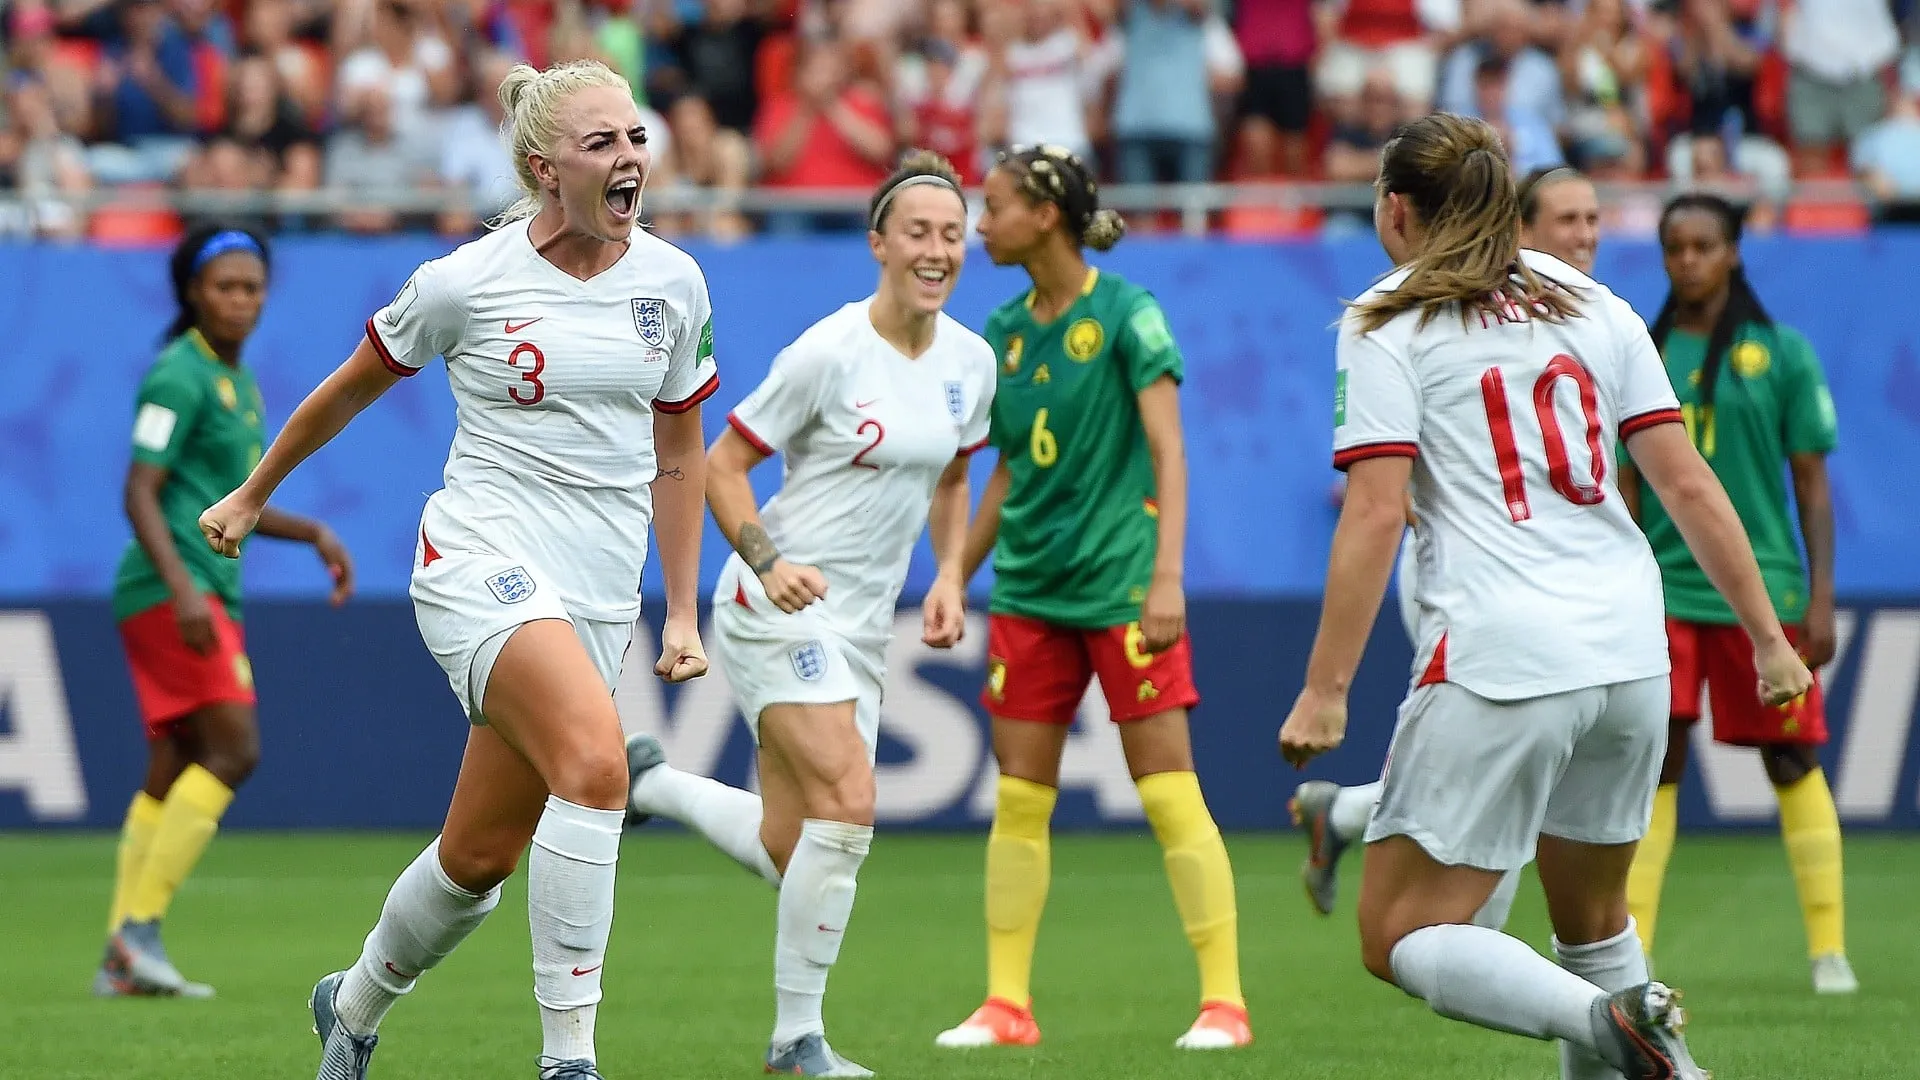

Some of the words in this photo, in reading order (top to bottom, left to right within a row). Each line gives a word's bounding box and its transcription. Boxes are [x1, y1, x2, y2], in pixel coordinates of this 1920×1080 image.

[508, 342, 545, 405] 3
[851, 419, 886, 470] 2
[1031, 408, 1058, 468] 6
[1480, 352, 1605, 522] 10
[613, 610, 1147, 821] VSA
